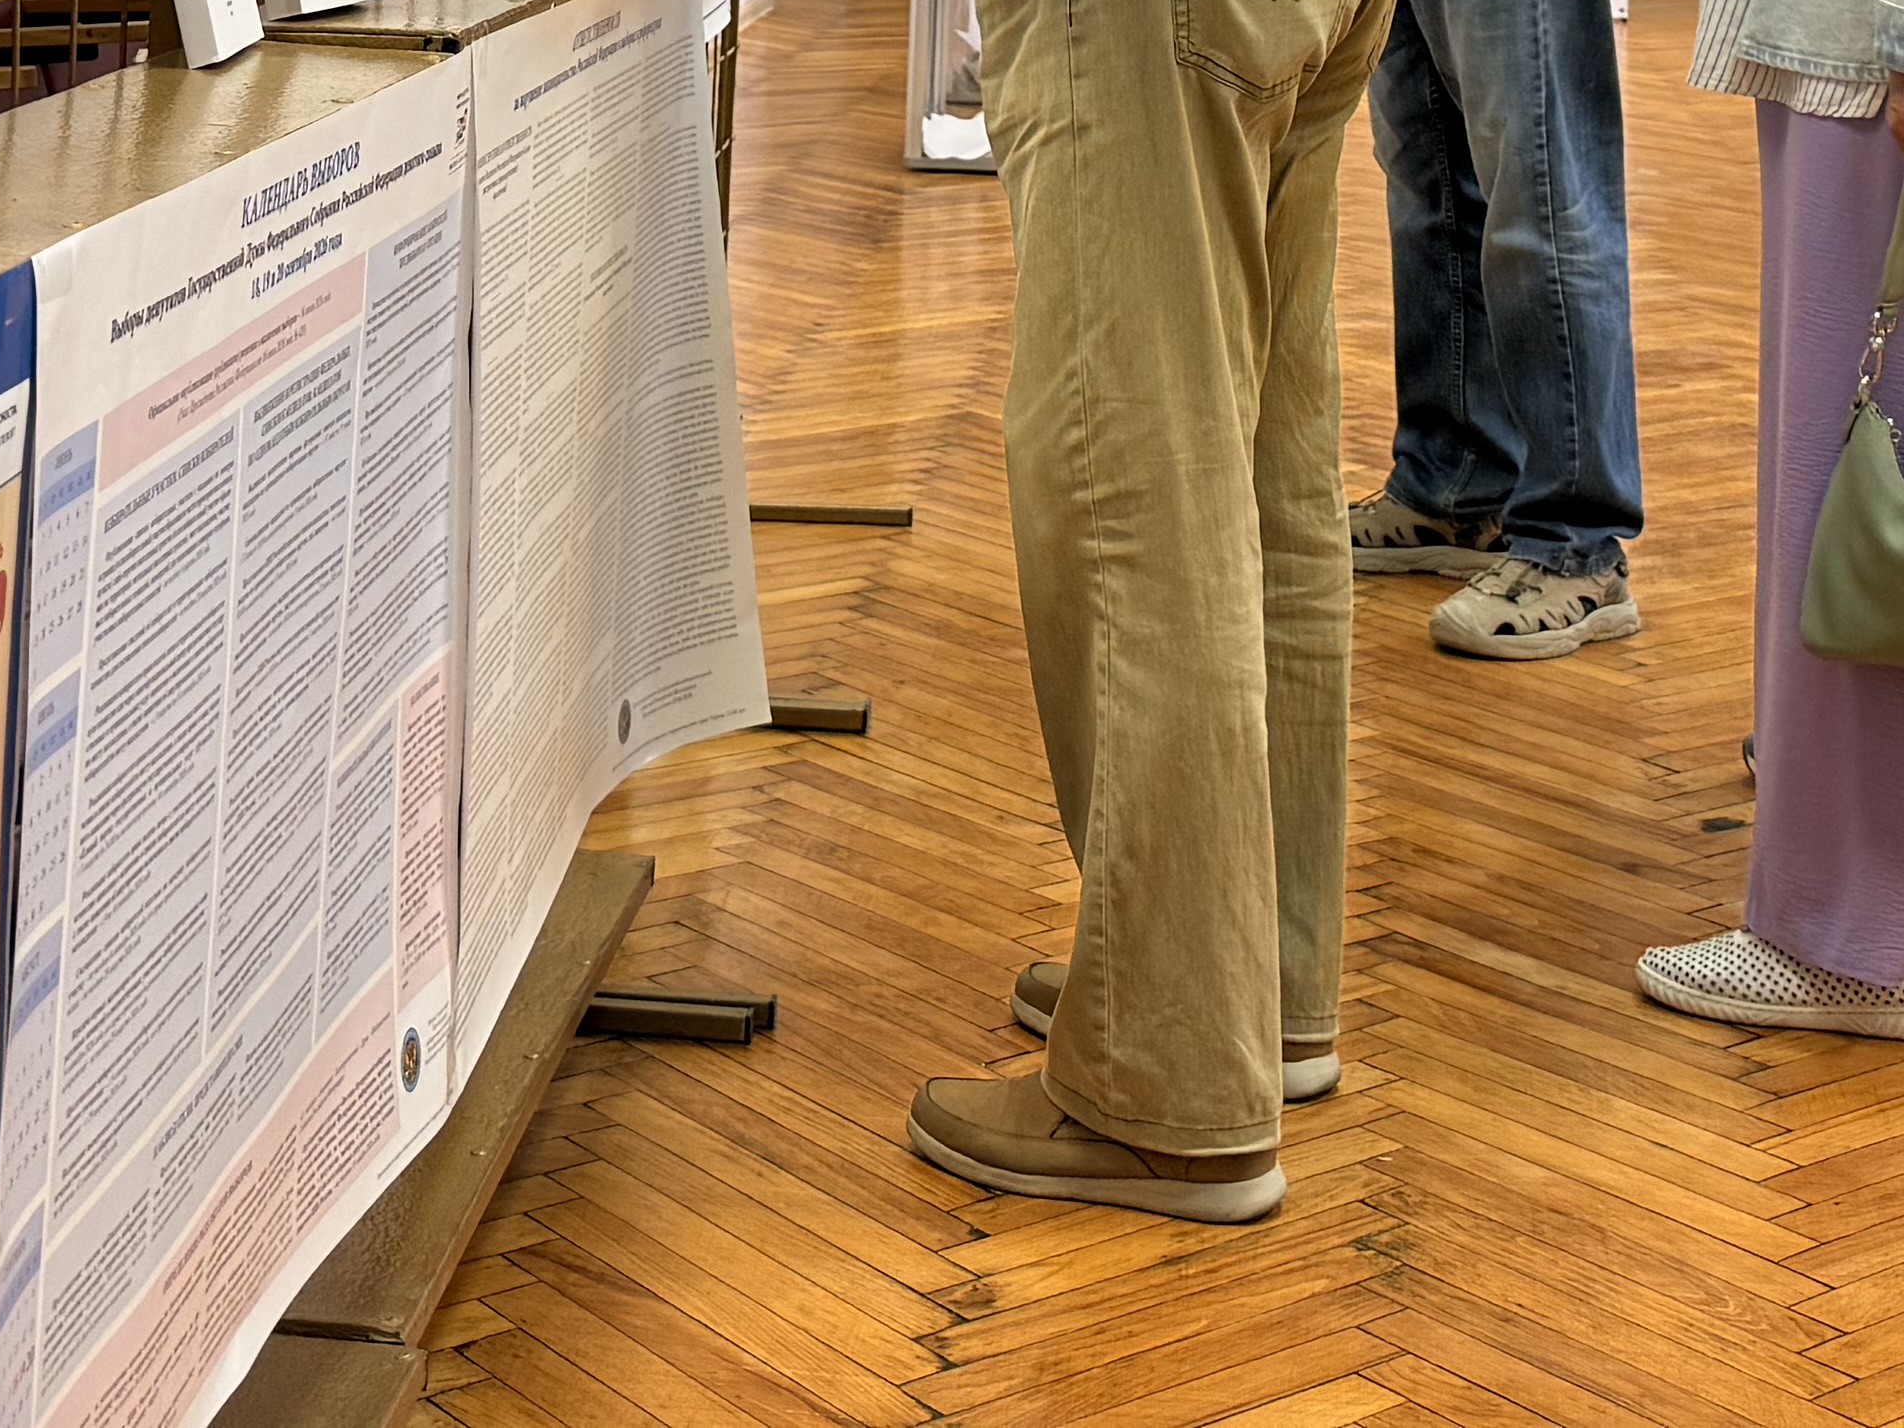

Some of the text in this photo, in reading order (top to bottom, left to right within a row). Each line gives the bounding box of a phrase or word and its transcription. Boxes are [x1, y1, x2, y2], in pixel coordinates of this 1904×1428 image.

[241, 141, 360, 228] КАЛЕНДАРЬ ВЫБОРОВ
[111, 308, 144, 343] Выборы
